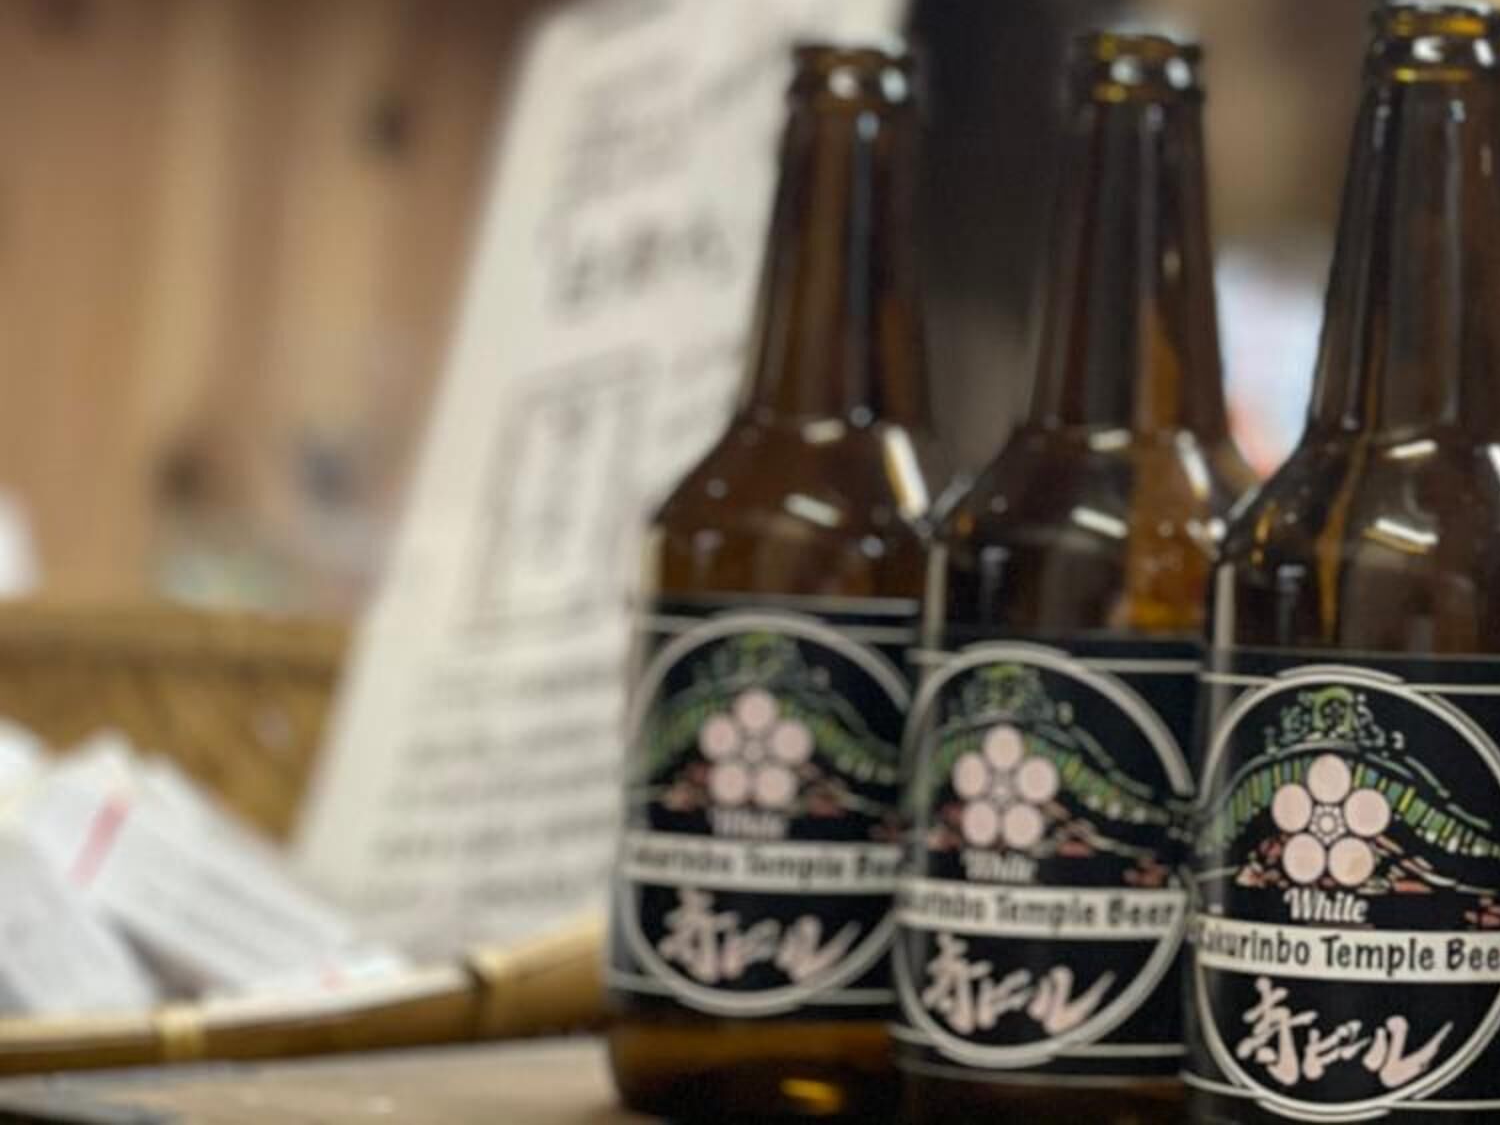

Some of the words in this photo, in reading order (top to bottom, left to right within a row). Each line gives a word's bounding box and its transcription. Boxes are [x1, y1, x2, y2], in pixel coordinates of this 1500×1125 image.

[995, 892, 1097, 937] Temple
[1107, 896, 1175, 928] Beer
[1319, 933, 1436, 978] Temple
